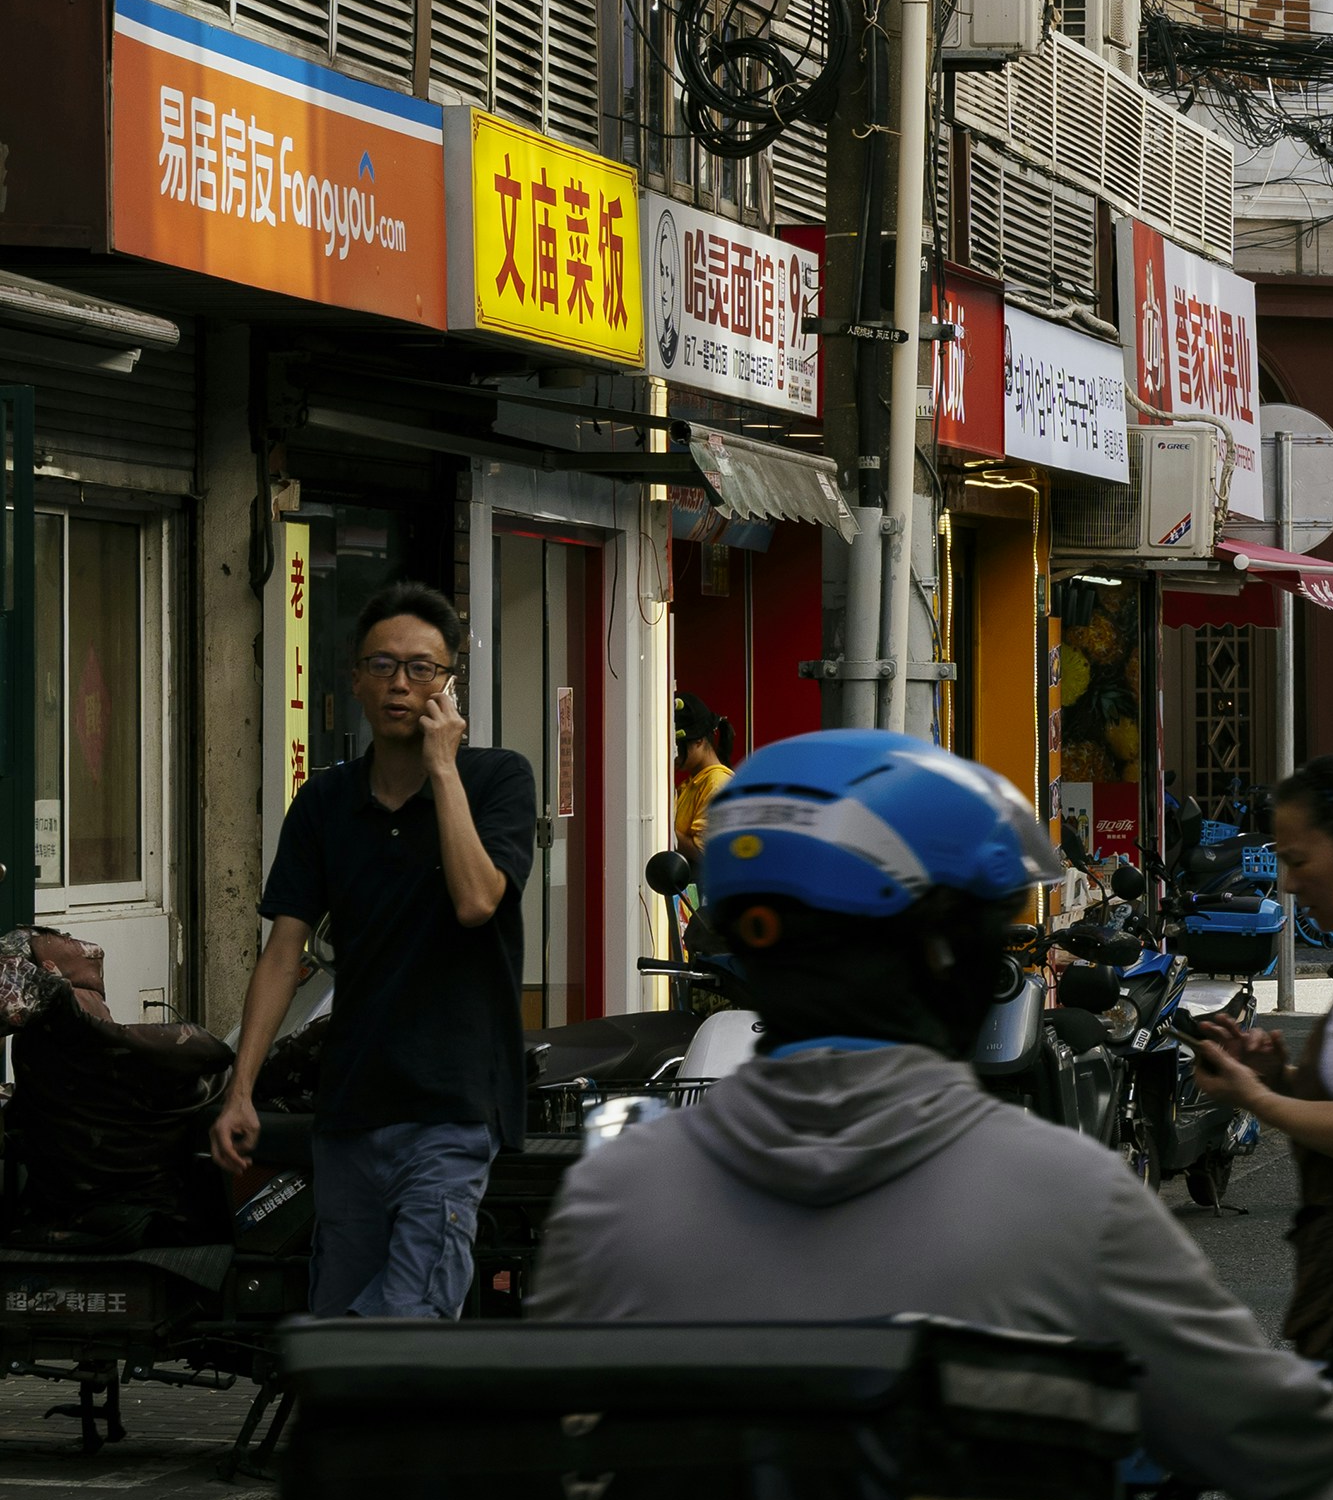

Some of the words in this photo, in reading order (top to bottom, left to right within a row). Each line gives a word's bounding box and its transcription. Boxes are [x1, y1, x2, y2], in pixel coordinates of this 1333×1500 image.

[158, 85, 276, 229] 易居房友
[280, 135, 407, 261] fangyou.com
[494, 154, 628, 331] 文庙菜饭
[684, 229, 774, 344] 哈灵面馆
[1096, 819, 1137, 832] 可口可乐
[5, 1291, 127, 1313] 超级载重王
